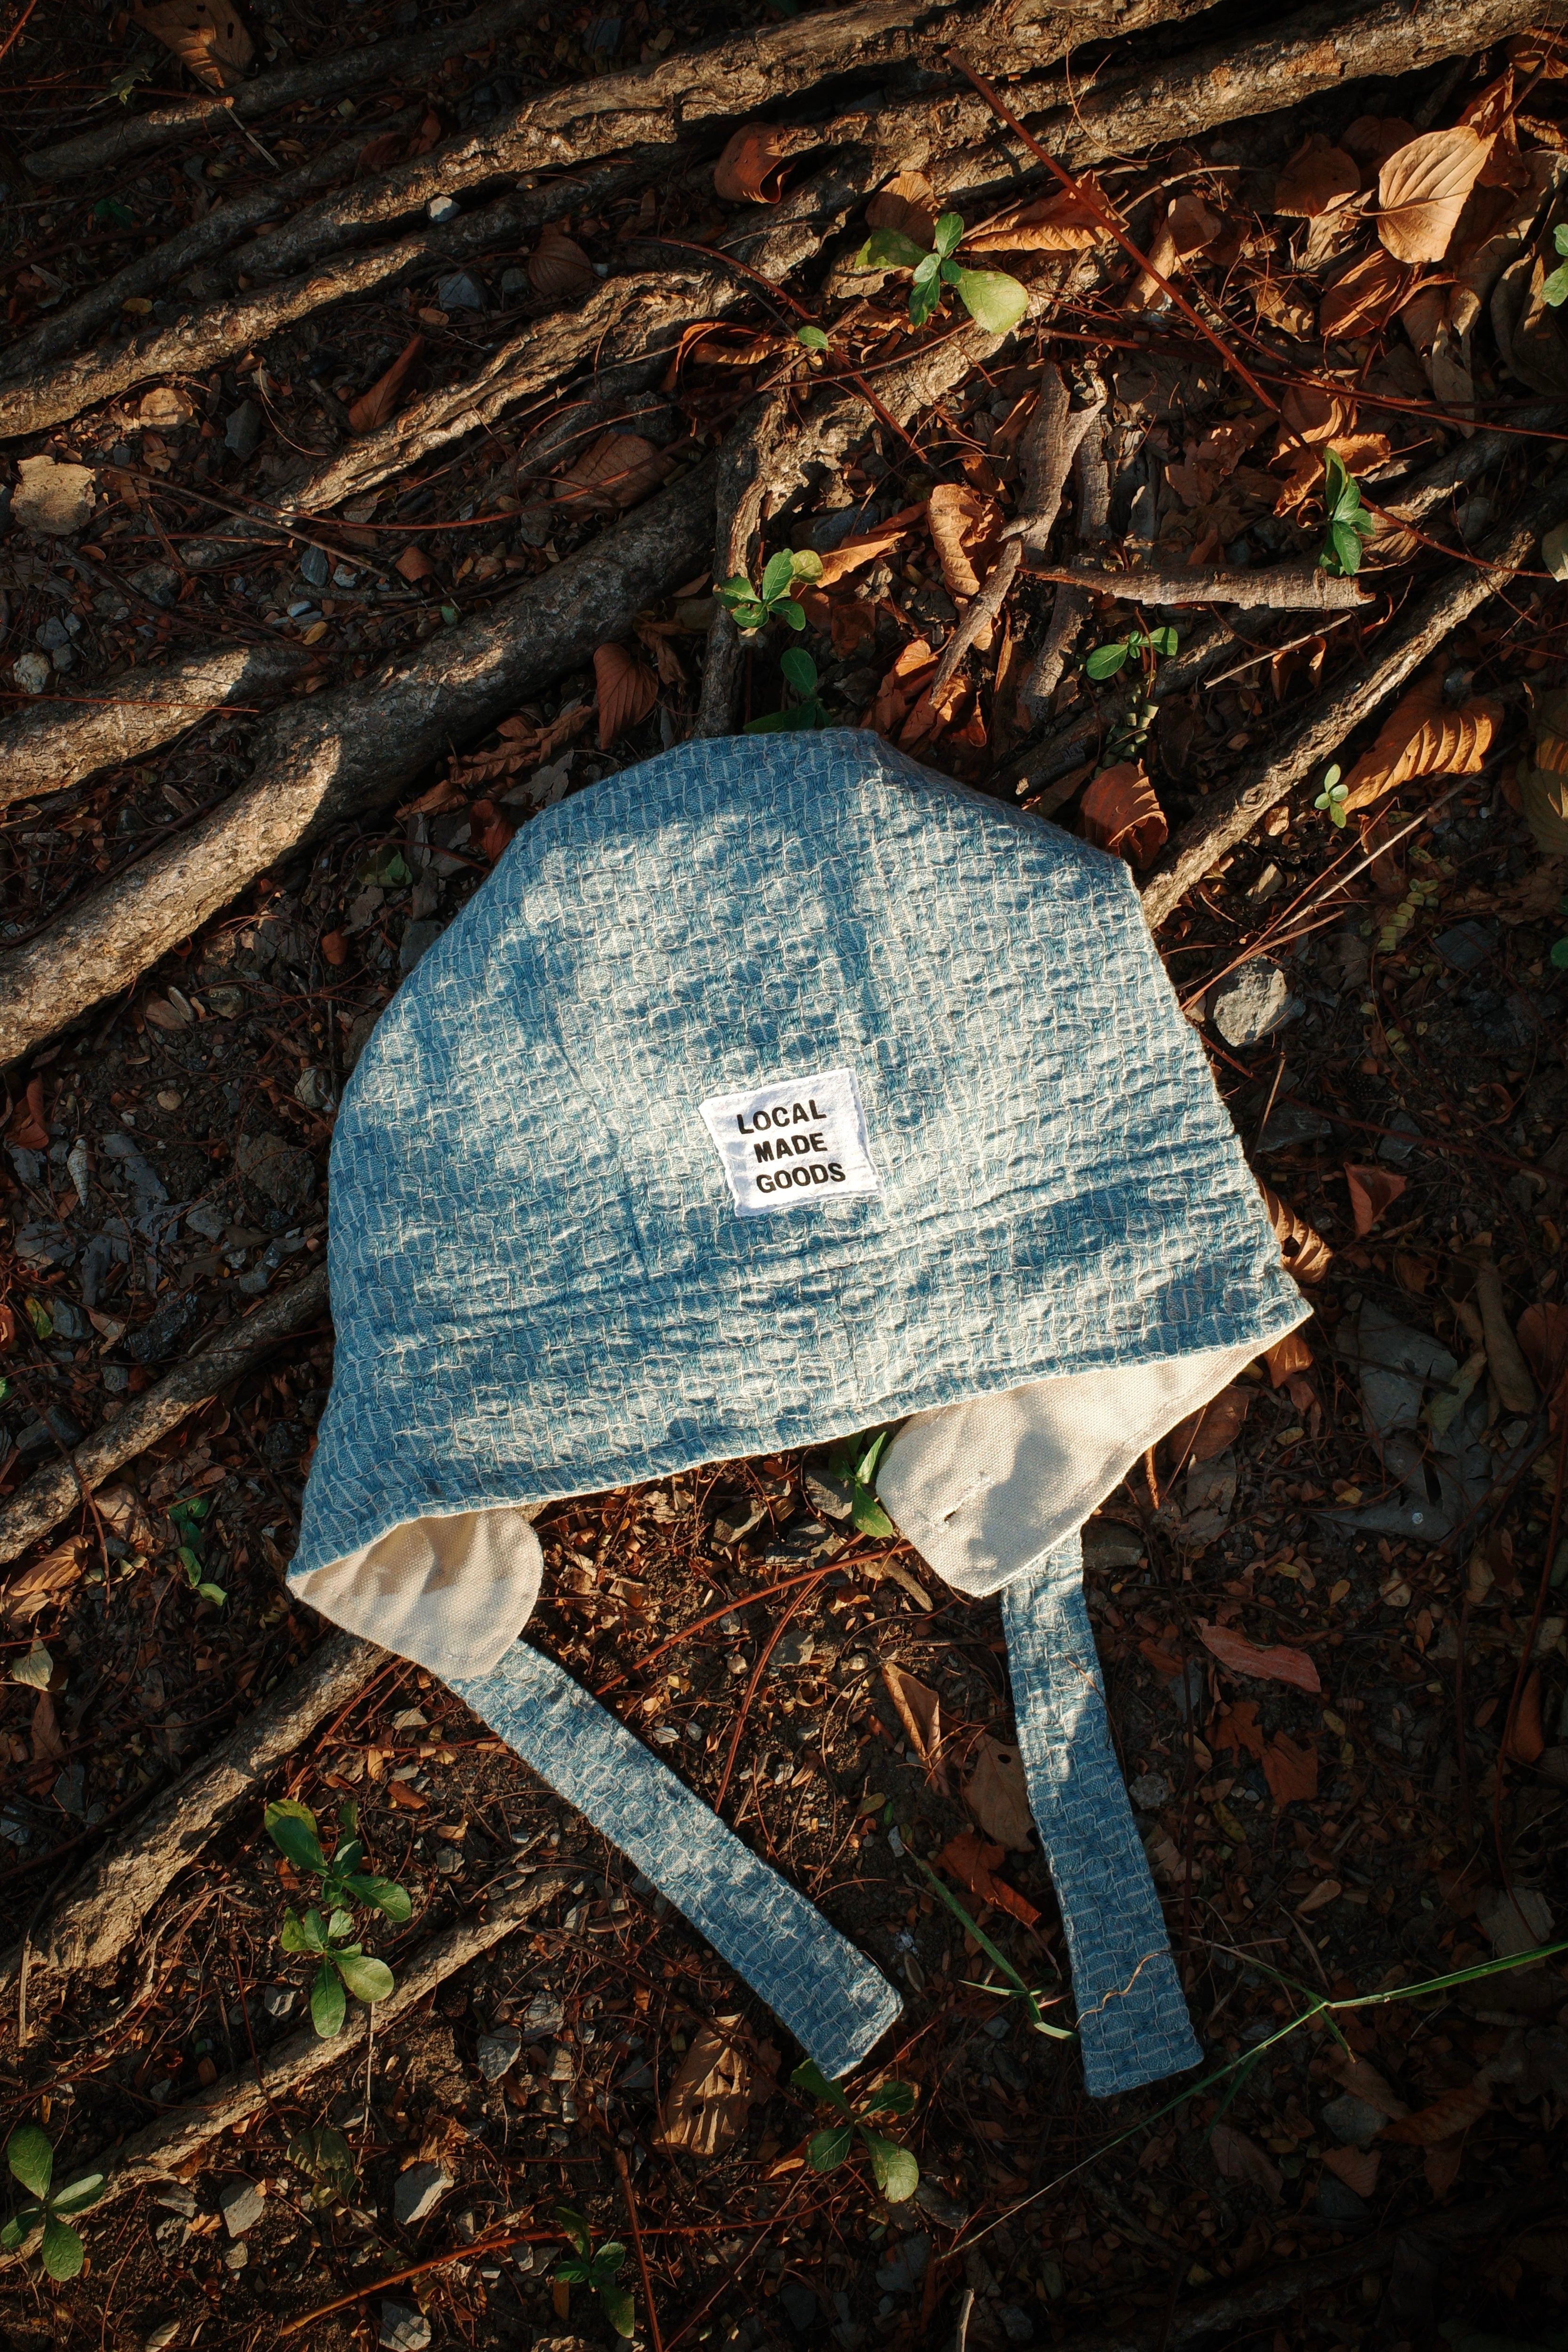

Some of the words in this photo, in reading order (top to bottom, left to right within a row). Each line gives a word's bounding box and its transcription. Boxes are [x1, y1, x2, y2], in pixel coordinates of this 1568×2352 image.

[737, 1100, 827, 1134] LOCAL
[754, 1132, 827, 1163] MADE
[756, 1162, 845, 1193] GOODS
